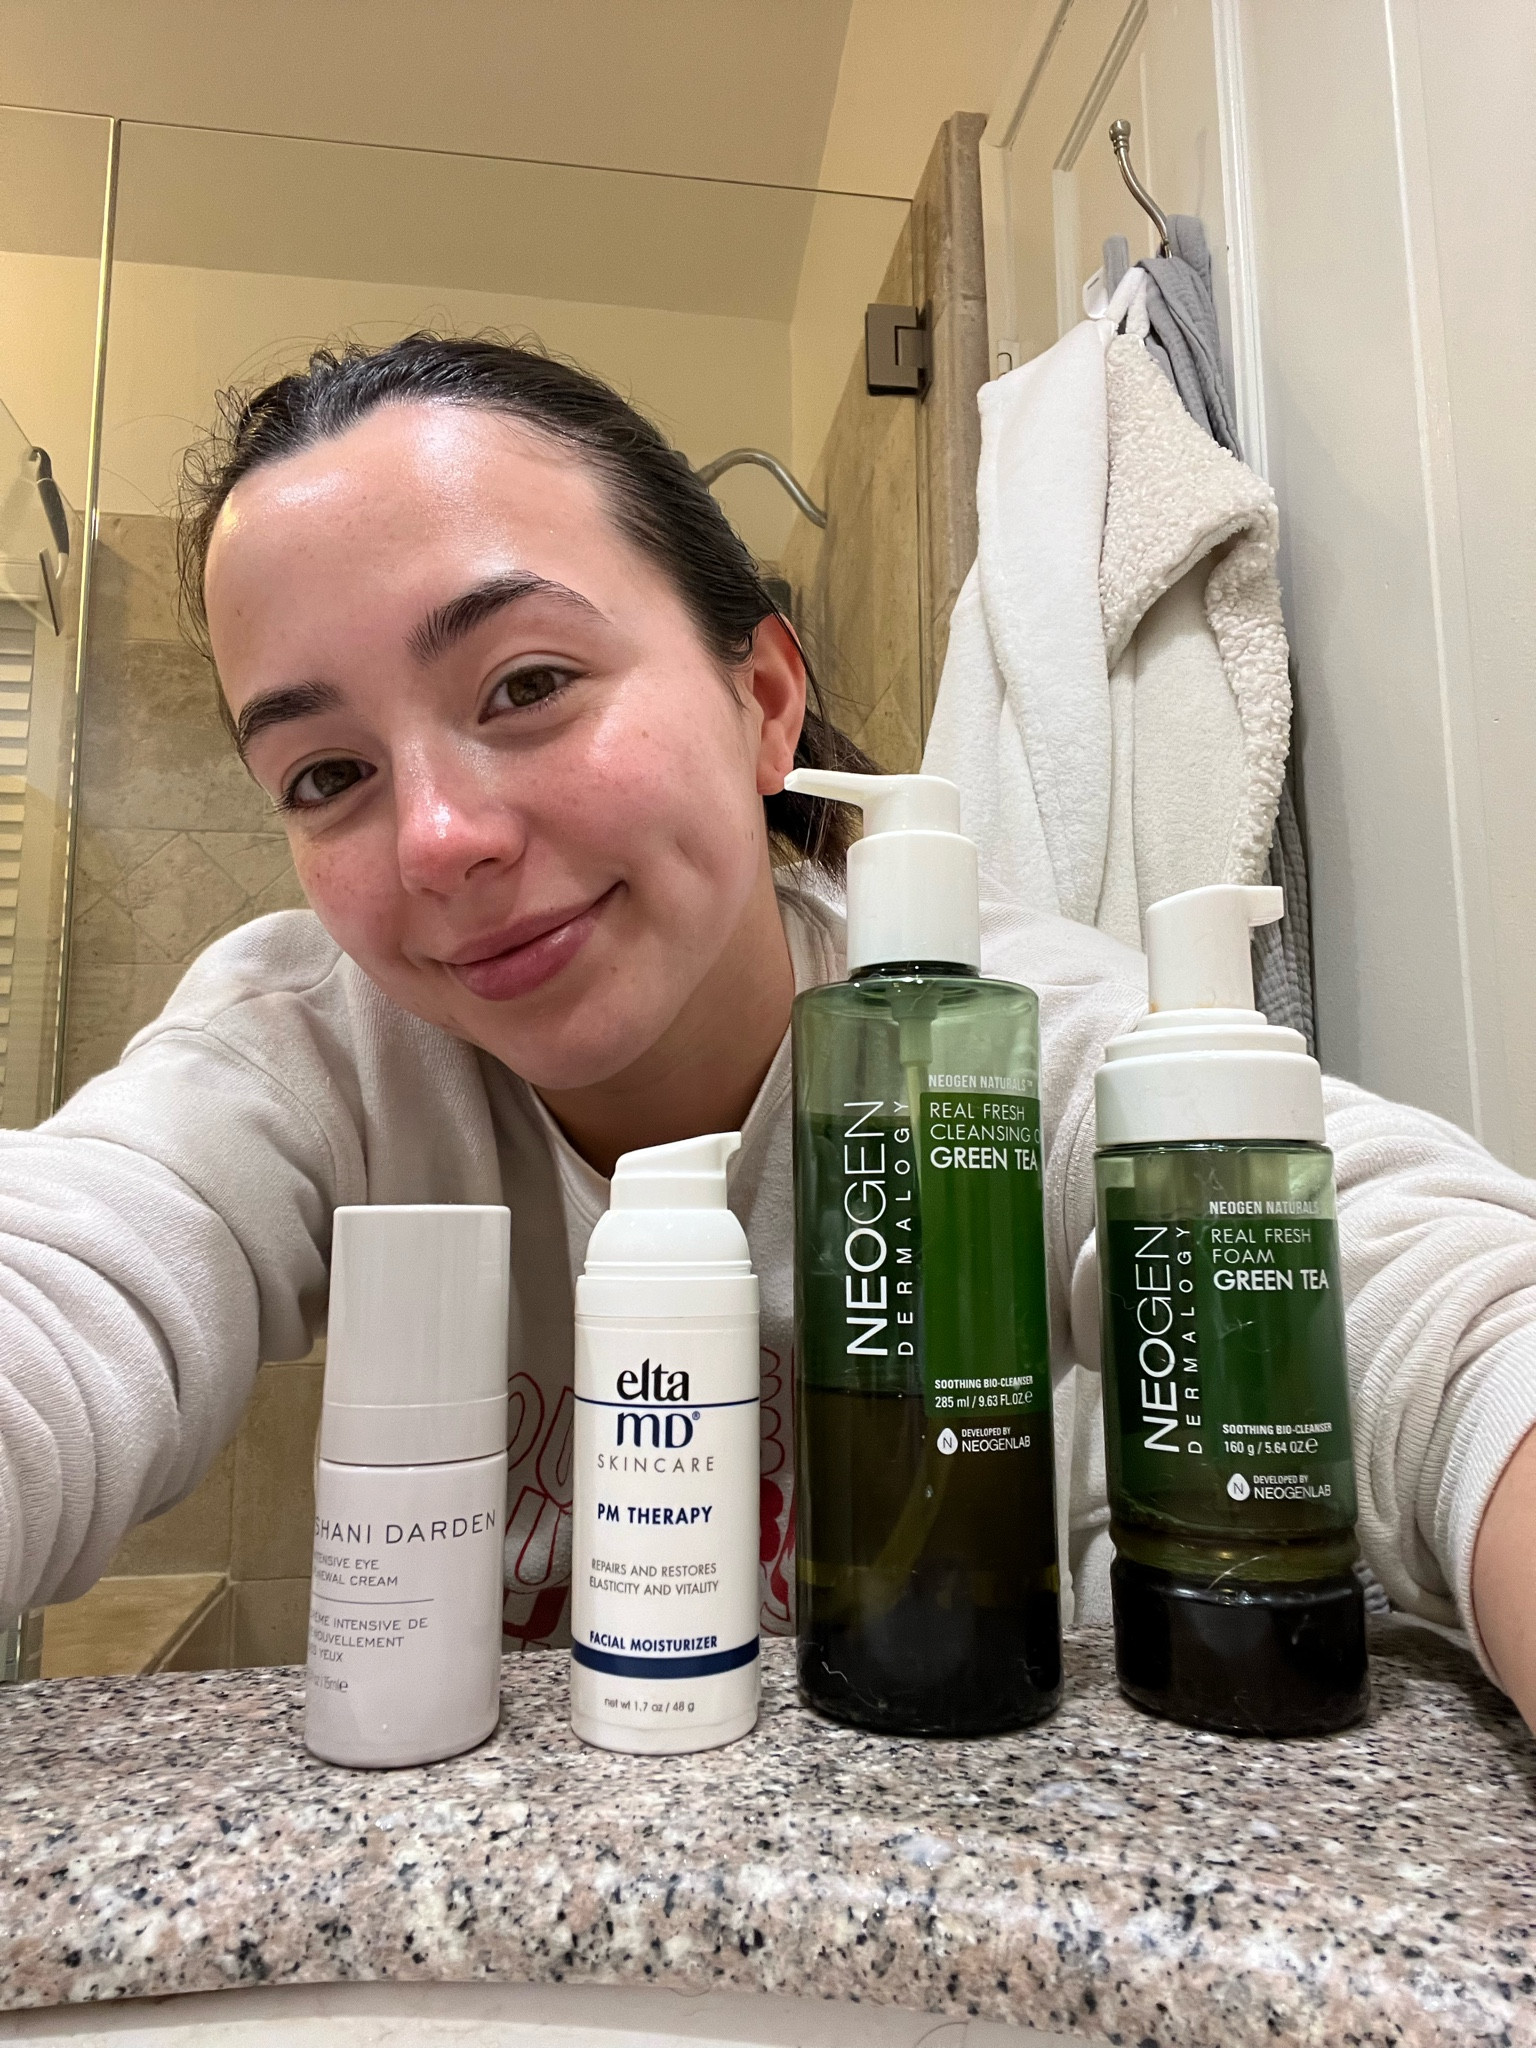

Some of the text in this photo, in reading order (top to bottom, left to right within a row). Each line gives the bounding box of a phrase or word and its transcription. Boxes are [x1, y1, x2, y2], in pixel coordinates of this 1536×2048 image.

[929, 1074, 977, 1088] NEOGEN
[930, 1102, 1025, 1121] REAL FRESH
[930, 1123, 1031, 1143] CLEANSING
[930, 1146, 1038, 1171] GREEN TEA
[1209, 1201, 1262, 1215] NEOGEN
[844, 1101, 888, 1356] NEOGEN
[894, 1101, 914, 1356] DERMALOGY
[1211, 1228, 1312, 1244] REAL FRESH
[1212, 1248, 1275, 1264] FOAM
[1213, 1268, 1330, 1291] GREEN TEA
[1134, 1227, 1180, 1453] NEOGEN
[1176, 1227, 1203, 1454] DERMALOGY
[616, 1358, 690, 1402] elta
[934, 1375, 1034, 1390] SOOTHING BIO-CLEANSER
[935, 1395, 954, 1409] 285
[957, 1395, 970, 1408] ml
[971, 1395, 977, 1409] /
[978, 1394, 998, 1408] 9.63
[961, 1426, 1011, 1438] DEVELOPED BY
[1222, 1422, 1333, 1435] SOOTHING BIO-CLEANSER
[961, 1435, 1031, 1452] NEOGENLAB
[1224, 1440, 1244, 1453] 160
[1247, 1443, 1255, 1456] g
[1257, 1442, 1262, 1455] /
[1265, 1441, 1287, 1454] 5.64
[598, 1454, 714, 1474] SKINCARE
[1253, 1475, 1308, 1485] DEVELOPED BY
[1254, 1485, 1331, 1500] NEOGENLAB
[598, 1503, 713, 1525] PM THERAPY
[315, 1509, 496, 1544] SHANI DARDEN
[355, 1559, 379, 1570] EYE
[592, 1558, 717, 1577] REPAIRS AND RESTORES
[350, 1575, 398, 1587] CREAM
[589, 1576, 719, 1596] ELASTICITY AND VITALITY
[333, 1617, 401, 1631] INTENSIVE
[408, 1617, 429, 1630] DE
[589, 1630, 718, 1653] FACIAL MOISTURIZER
[318, 1648, 344, 1663] YEUX
[604, 1697, 695, 1713] net wt 1.7 oz / 48 g
